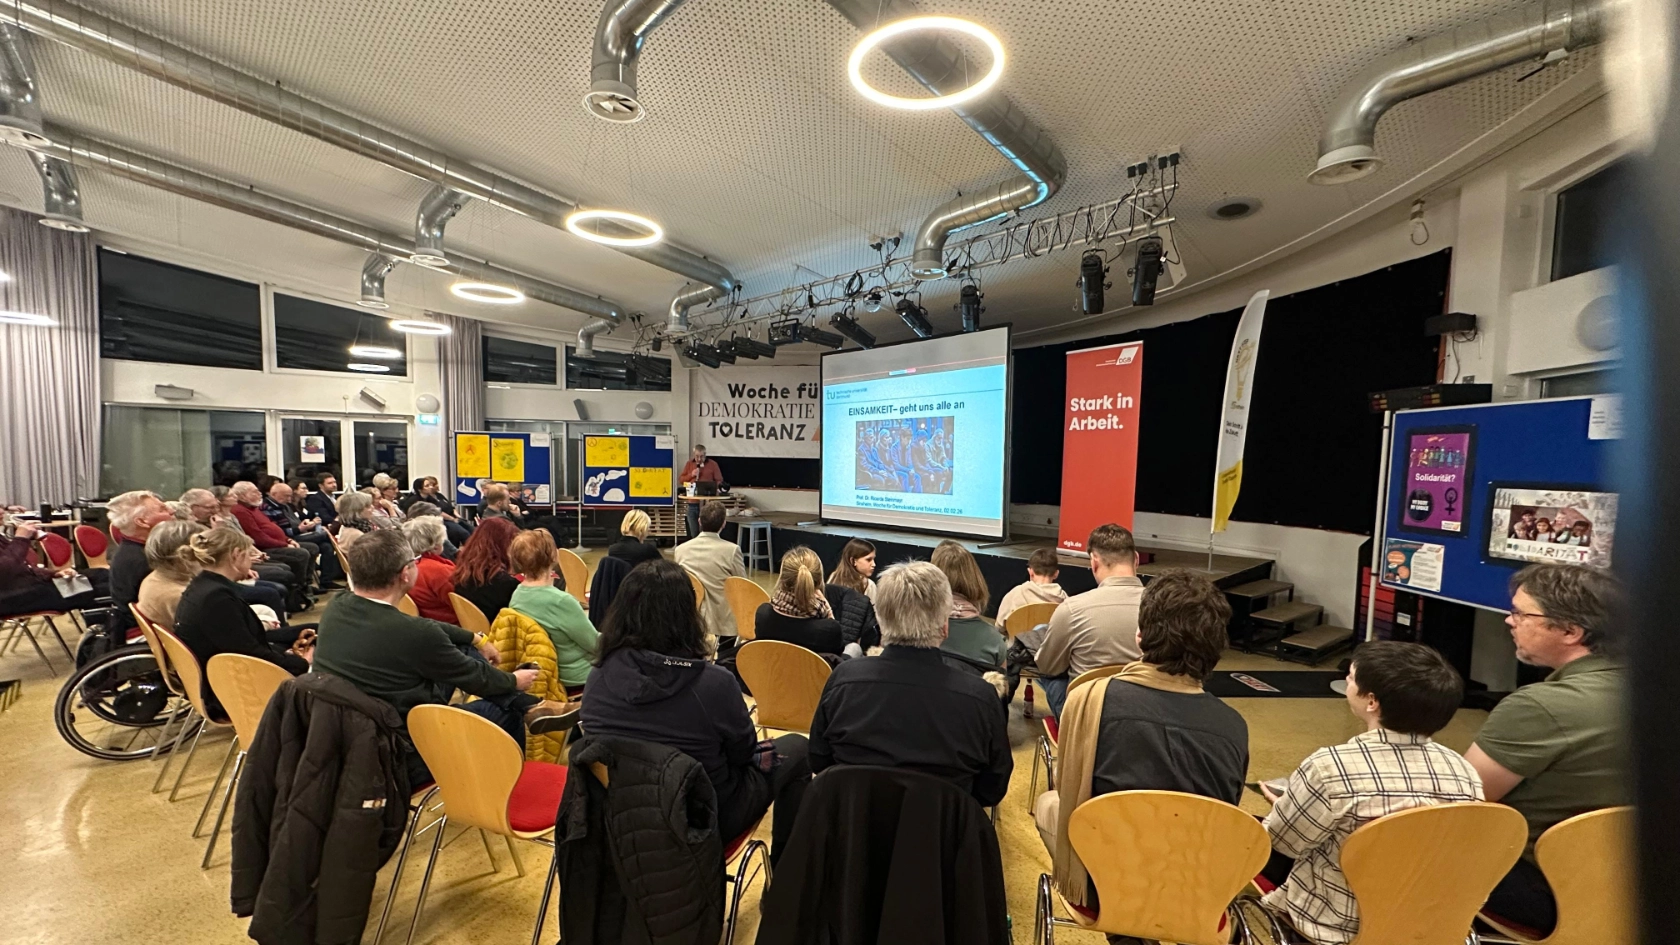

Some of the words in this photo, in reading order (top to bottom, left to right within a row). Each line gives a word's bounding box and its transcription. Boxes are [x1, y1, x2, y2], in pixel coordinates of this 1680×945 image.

[727, 383, 790, 399] Woche
[797, 382, 818, 399] fü
[698, 402, 815, 419] DEMOKRATIE
[900, 403, 917, 415] geht
[919, 403, 934, 411] uns
[936, 401, 951, 410] alle
[954, 401, 965, 409] an
[1070, 394, 1114, 412] Stark
[1116, 392, 1133, 409] in
[1069, 413, 1124, 431] Arbeit.
[708, 421, 807, 441] TOLERANZ
[1415, 472, 1456, 482] Solidarität?
[1063, 540, 1082, 548] dgb.de
